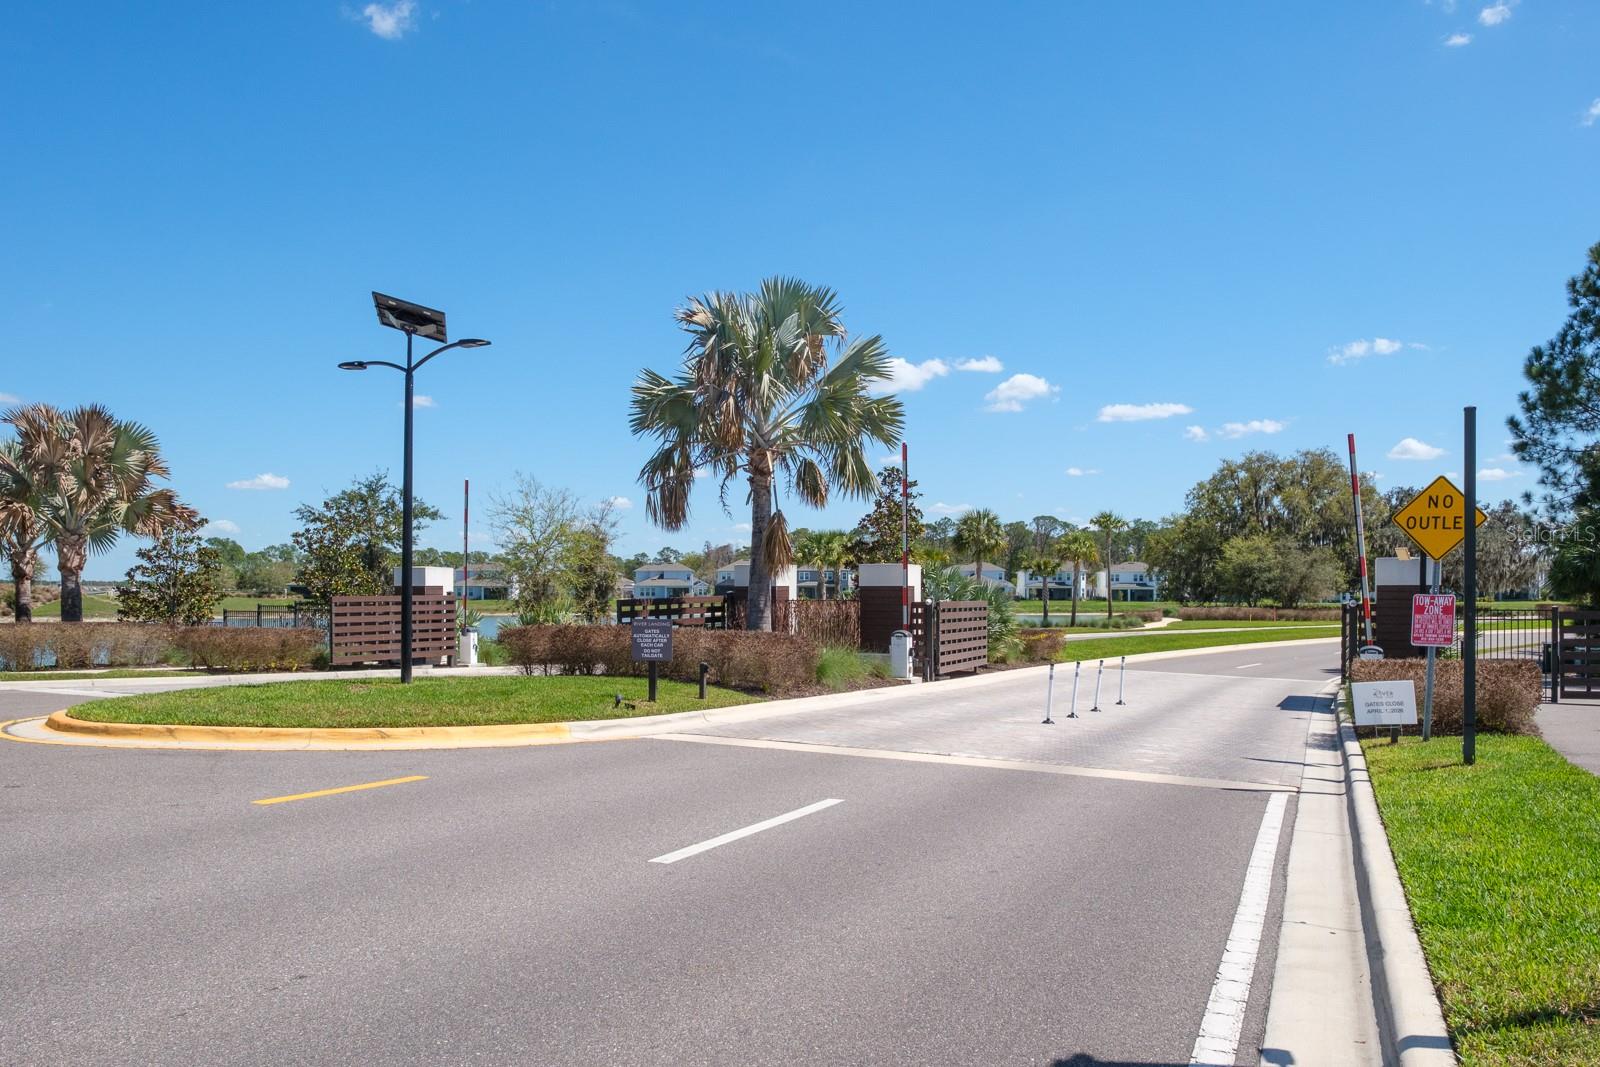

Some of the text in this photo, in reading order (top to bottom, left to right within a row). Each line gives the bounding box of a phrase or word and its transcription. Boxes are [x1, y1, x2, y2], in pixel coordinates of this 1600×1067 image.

[1428, 494, 1454, 509] NO
[1406, 516, 1463, 530] OUTLE
[1415, 596, 1453, 606] TOW-AWAY
[1424, 605, 1443, 615] ZONE
